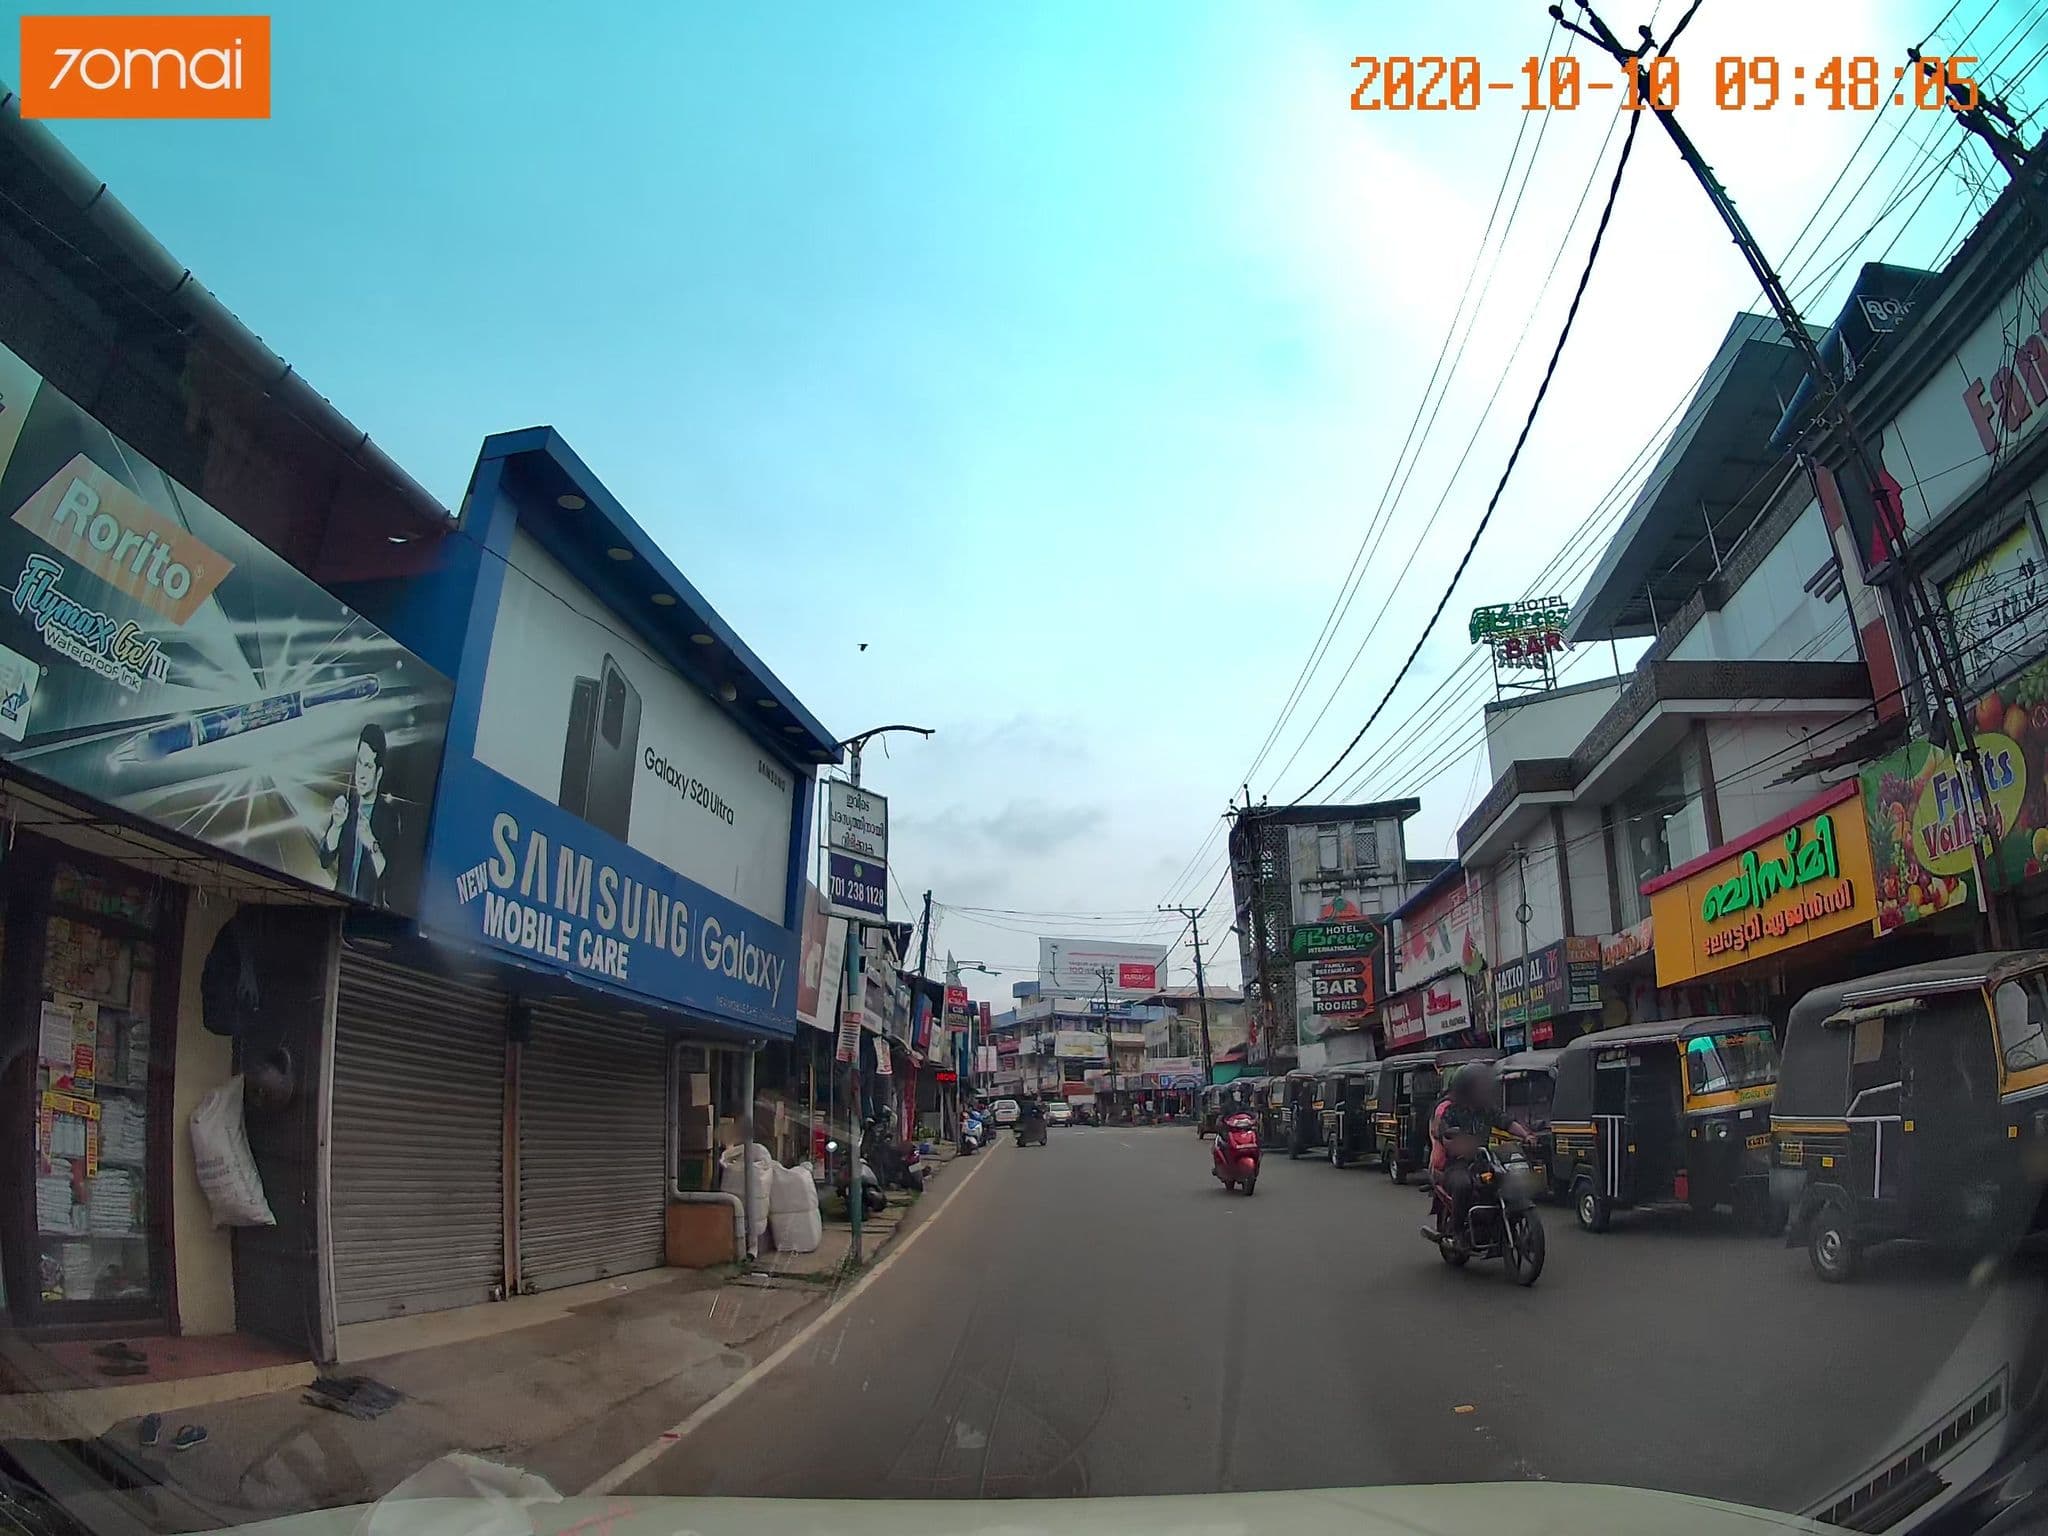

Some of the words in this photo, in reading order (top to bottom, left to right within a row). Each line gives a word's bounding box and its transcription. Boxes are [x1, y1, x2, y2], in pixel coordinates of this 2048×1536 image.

[52, 477, 193, 601] Rorito
[14, 555, 117, 652] Flymax
[112, 620, 157, 674] Gel
[1514, 596, 1569, 612] HOTEL
[48, 630, 119, 680] Waterproof
[120, 671, 141, 690] Ink
[1507, 632, 1564, 659] BAR
[644, 747, 690, 800] Galaxy
[690, 779, 710, 809] S20
[710, 793, 734, 825] Ultra
[1932, 750, 2014, 824] Frts
[456, 861, 489, 905] NEW
[1702, 813, 1839, 923] ബിസ്മി
[487, 812, 689, 959] SAMSUNG
[701, 916, 786, 1007] Galaxy
[831, 876, 845, 897] 701
[847, 880, 864, 902] 238
[866, 885, 884, 908] 1128
[483, 891, 573, 962] MOBILE
[578, 928, 631, 981] CARE
[1307, 928, 1374, 948] Breeze
[1326, 925, 1360, 935] HOTEL
[1315, 979, 1358, 995] BAR
[1495, 958, 1544, 994] NATIOAL
[1316, 1000, 1358, 1011] ROOMS
